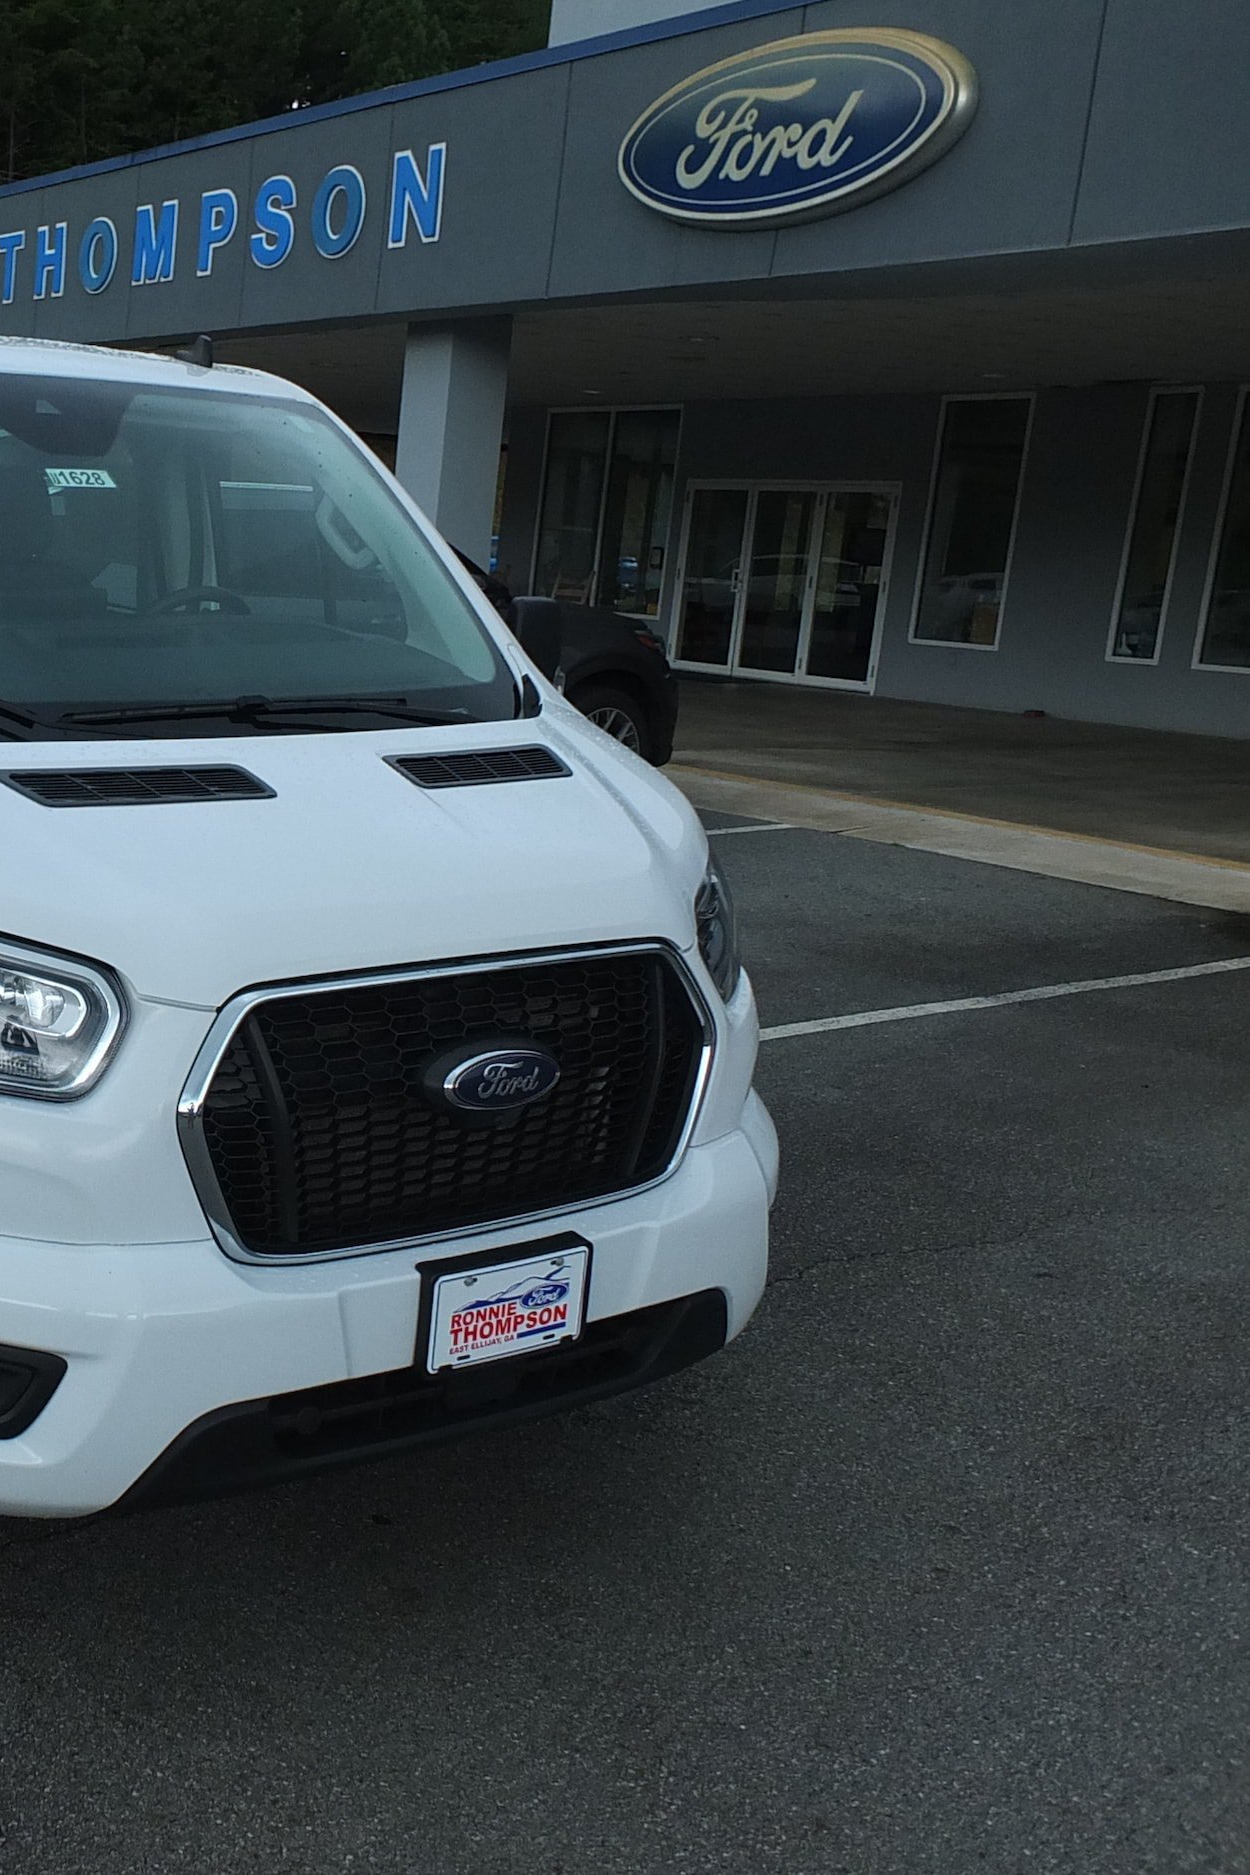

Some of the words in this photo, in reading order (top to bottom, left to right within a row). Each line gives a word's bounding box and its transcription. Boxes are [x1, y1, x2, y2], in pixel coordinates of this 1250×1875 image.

[675, 78, 864, 189] Ford
[479, 1062, 539, 1098] Ford
[529, 1287, 560, 1304] Ford
[449, 1305, 568, 1345] THOMPSON
[451, 1301, 517, 1328] RONNIE
[449, 1345, 469, 1355] EAST
[503, 1335, 514, 1343] GA
